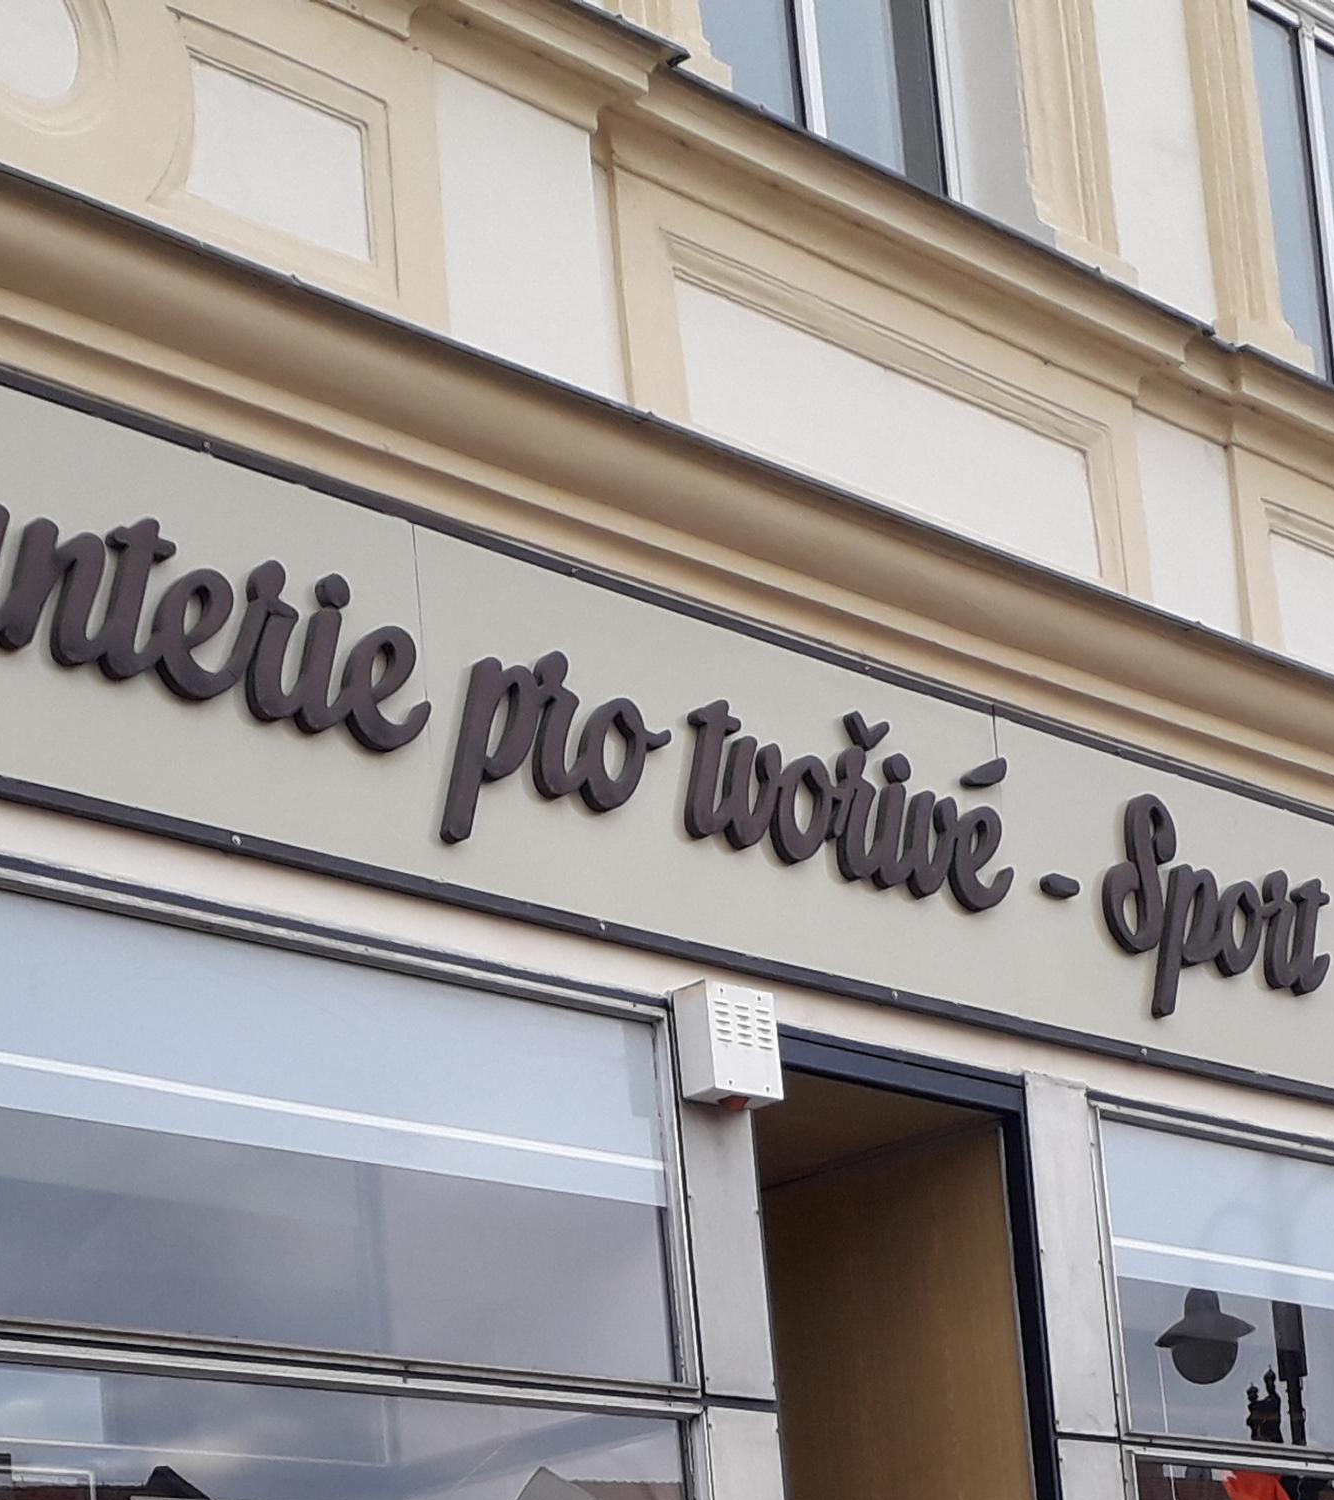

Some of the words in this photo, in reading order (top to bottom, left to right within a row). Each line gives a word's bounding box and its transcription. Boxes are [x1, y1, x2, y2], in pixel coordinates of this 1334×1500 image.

[438, 650, 671, 843] pro
[683, 699, 1014, 912] tvořivé
[1101, 793, 1331, 1018] Sport
